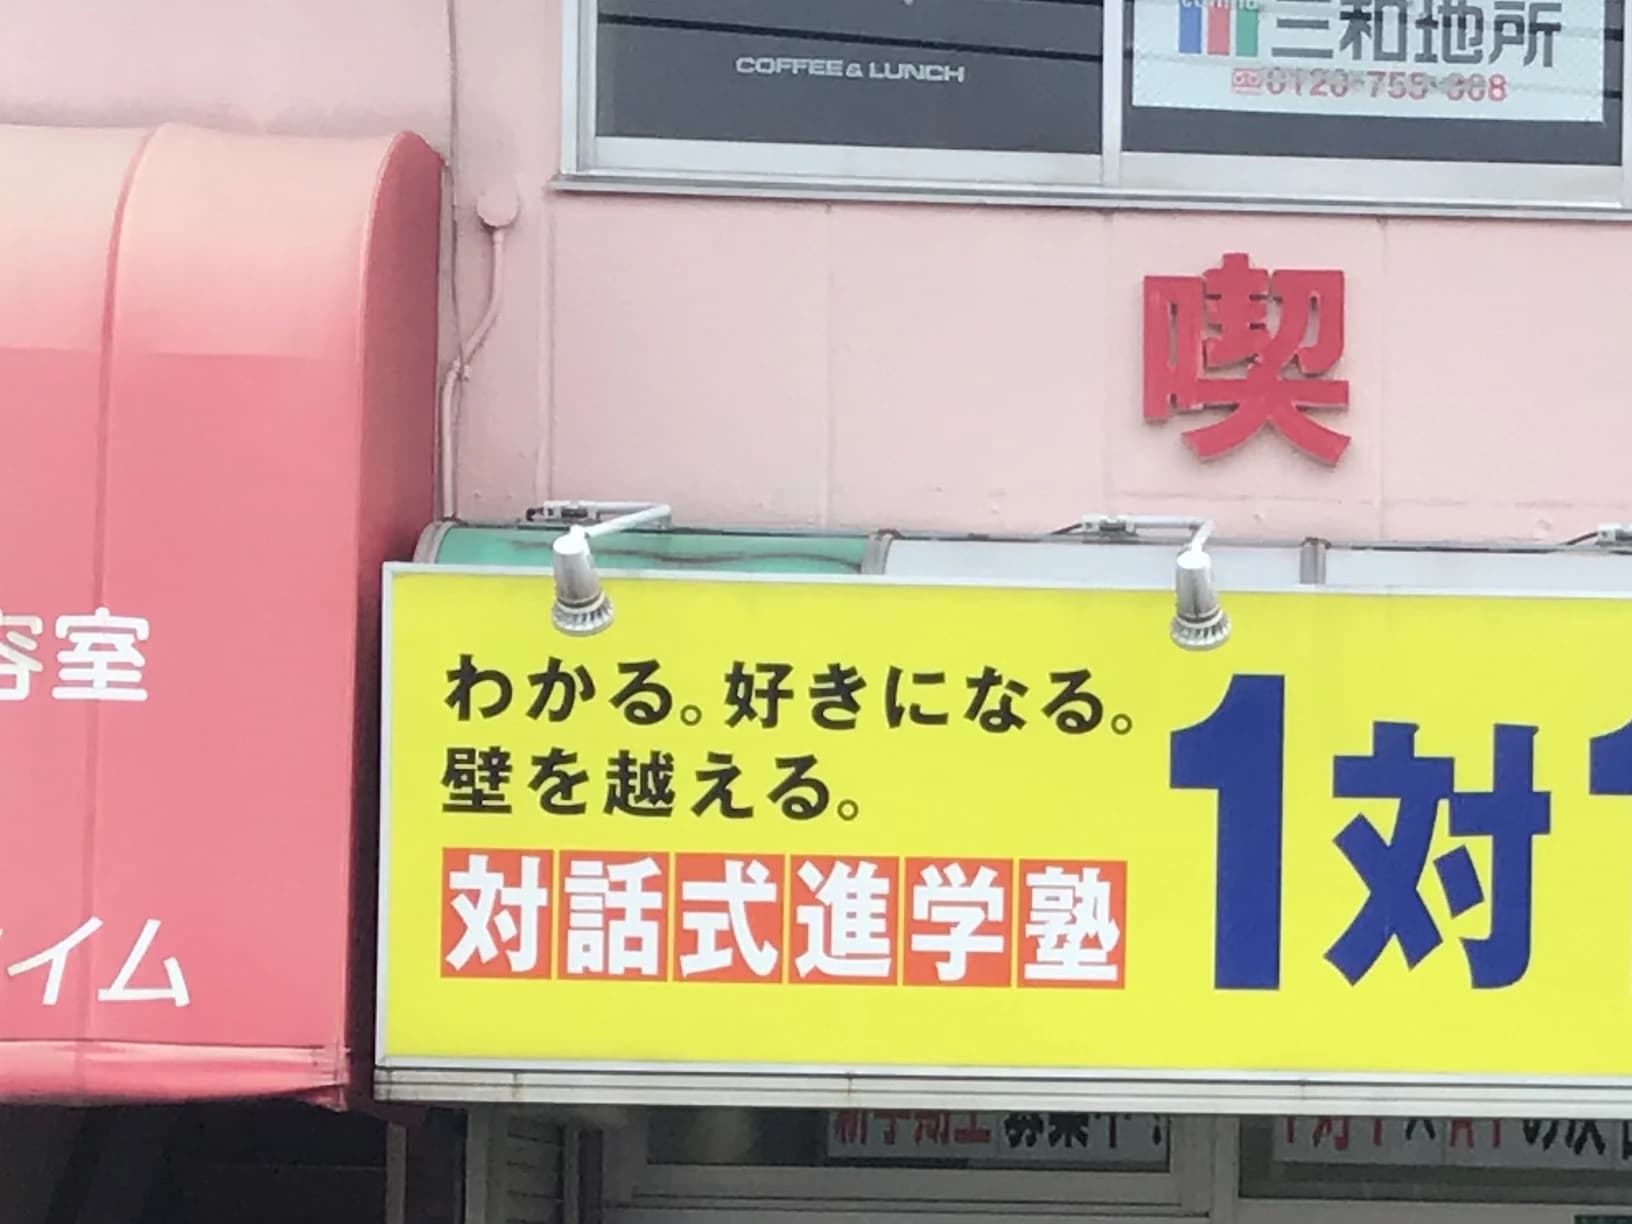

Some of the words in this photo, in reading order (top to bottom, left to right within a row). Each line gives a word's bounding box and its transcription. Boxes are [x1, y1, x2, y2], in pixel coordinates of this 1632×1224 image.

[735, 57, 843, 77] COFFEE
[869, 62, 966, 82] LUNCH
[440, 746, 859, 822] 壁を越える。
[446, 853, 1121, 982] 対話式進学塾
[0, 916, 191, 1007] イム
